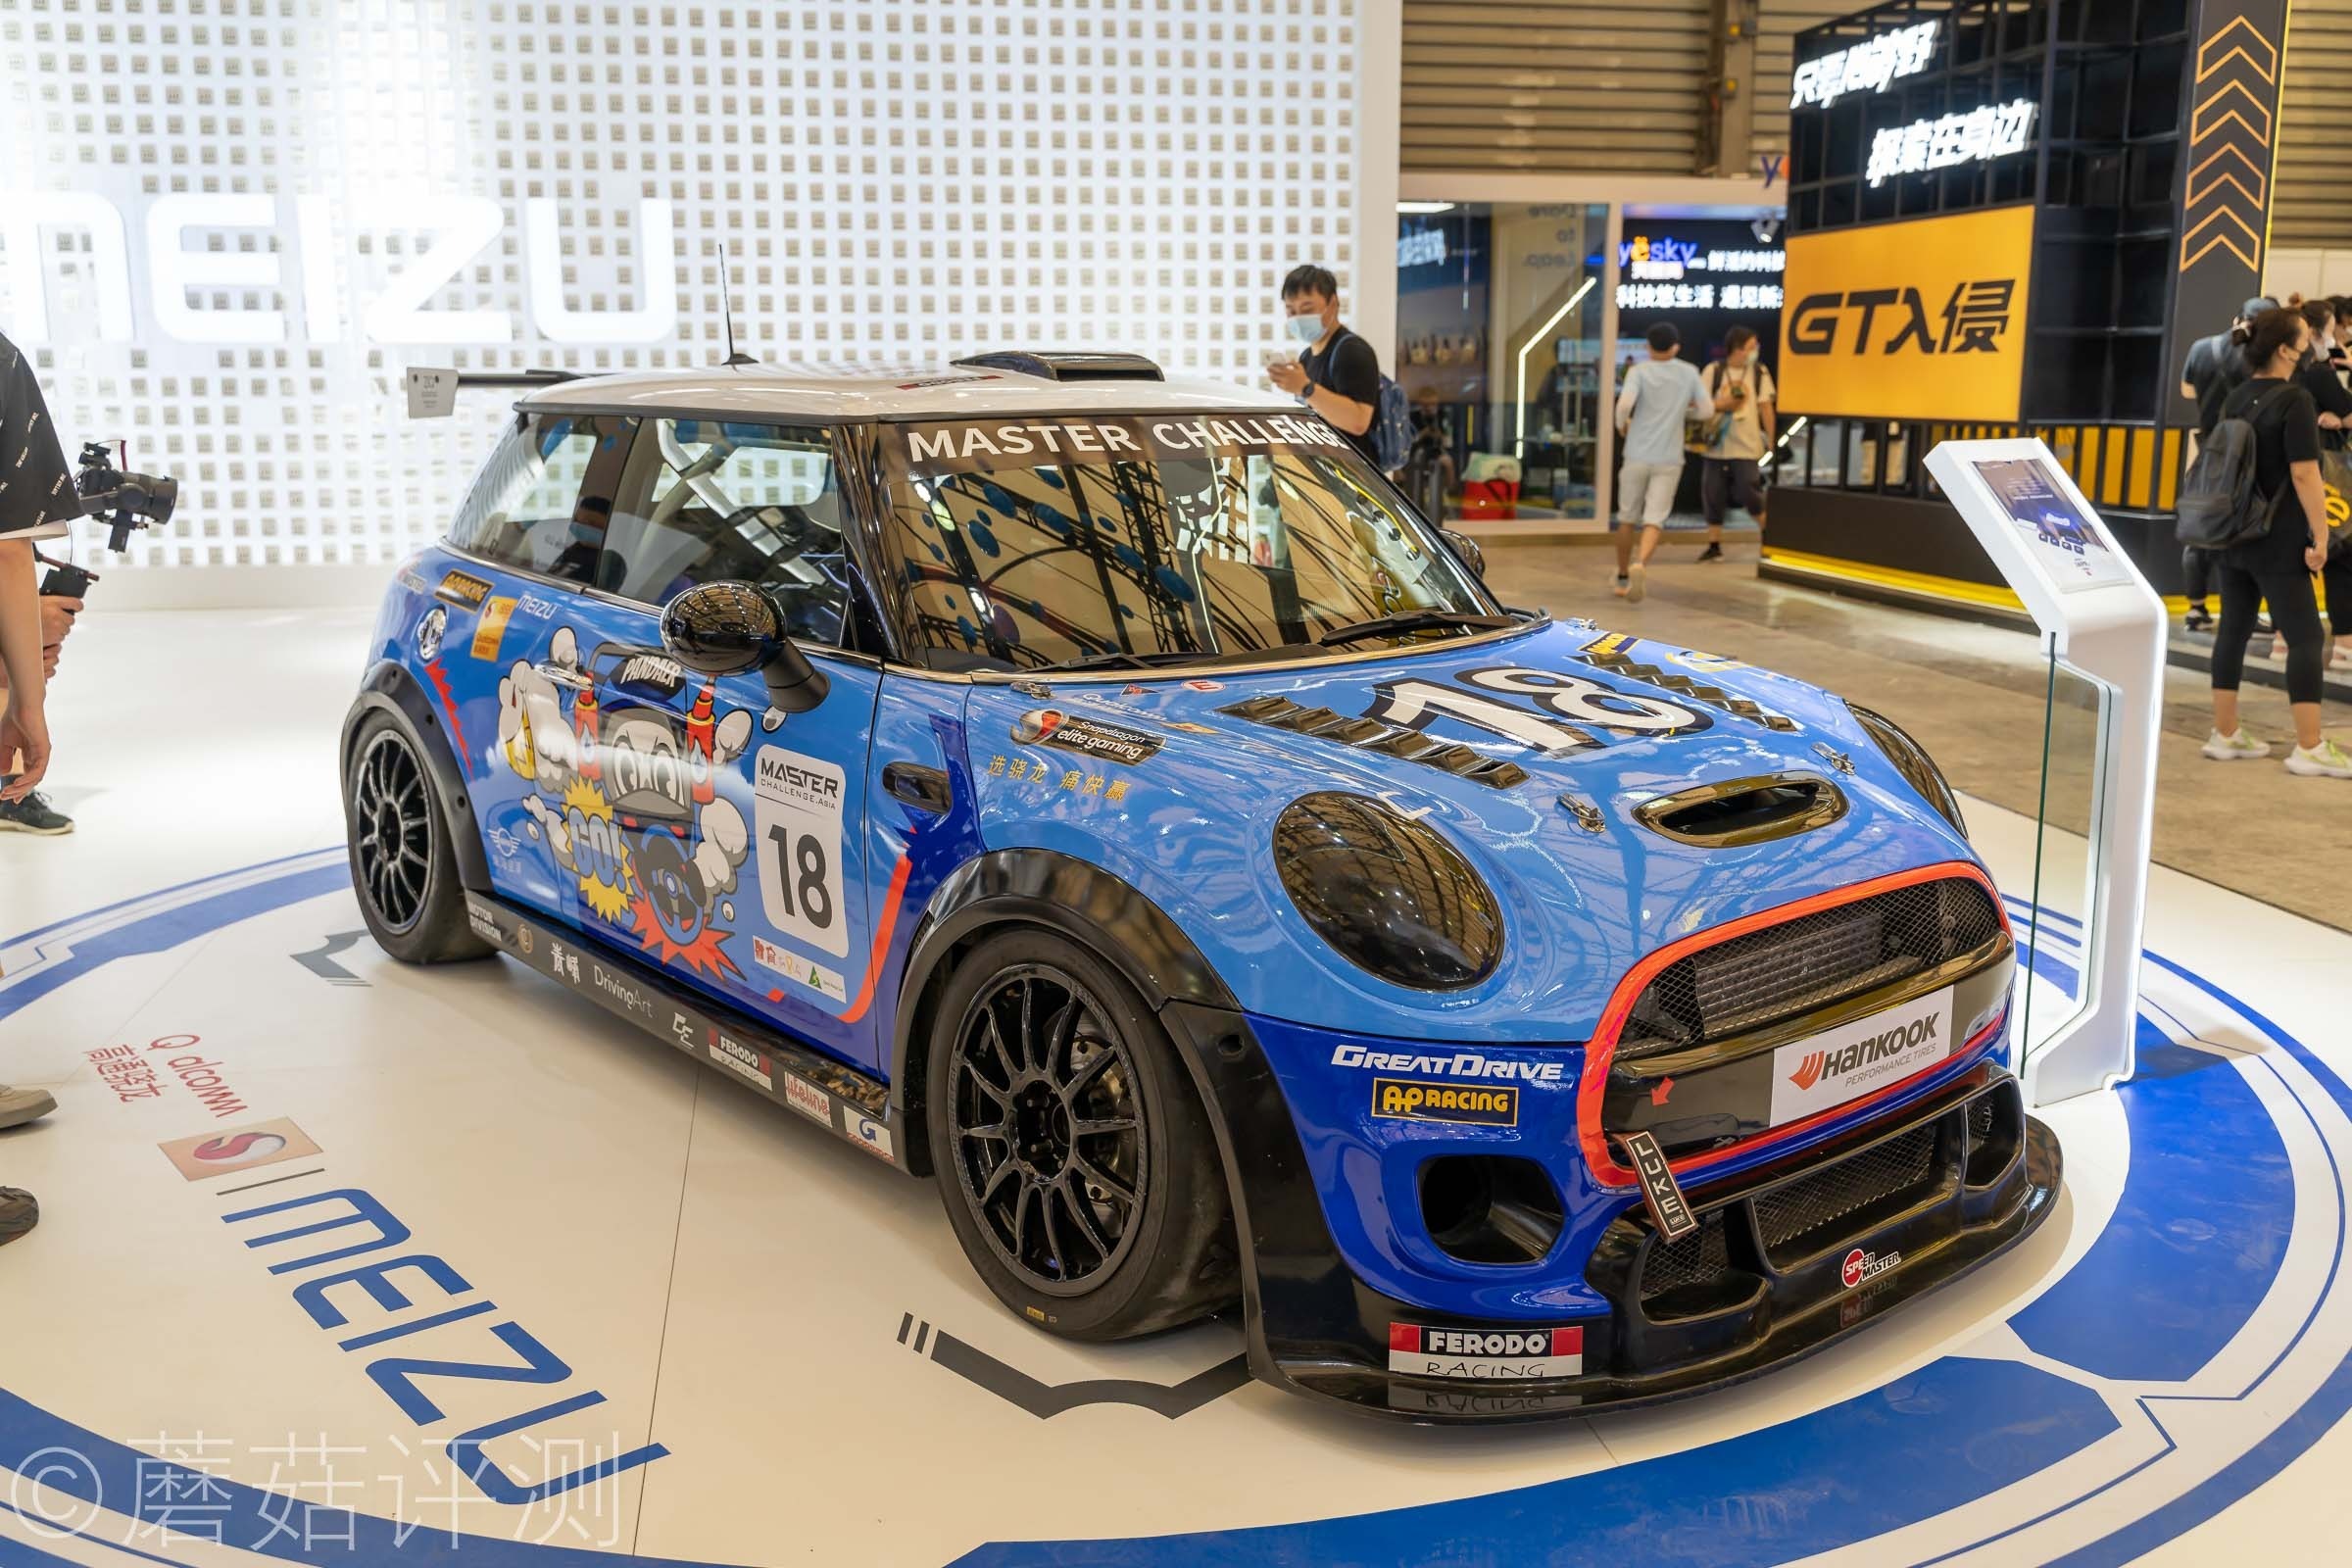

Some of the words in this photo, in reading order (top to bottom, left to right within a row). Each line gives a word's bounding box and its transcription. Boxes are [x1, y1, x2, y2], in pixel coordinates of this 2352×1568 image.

[908, 423, 1142, 463] MASTER
[1152, 415, 1350, 452] CHALLENGE
[516, 594, 559, 619] MEIZU
[620, 656, 681, 687] PANDAER
[1370, 666, 1707, 758] 18
[1057, 729, 1087, 744] elite
[1086, 737, 1143, 760] gaming
[1080, 721, 1146, 744] Snapdragon
[761, 758, 838, 799] MASTER
[988, 754, 1050, 785] 选骁龙
[1059, 769, 1130, 802] 痛快赢
[768, 823, 833, 929] 18
[720, 1035, 760, 1068] FERODO
[1845, 1053, 1912, 1087] PERFORMANCE
[1913, 1043, 1936, 1059] TIRES
[1425, 1089, 1508, 1112] RACING
[1635, 1142, 1681, 1215] LUKE
[1845, 1252, 1876, 1276] SPEED
[1862, 1251, 1901, 1281] MASTER
[220, 1188, 671, 1505] MEIZU
[1429, 1331, 1546, 1354] FERODO
[1426, 1361, 1545, 1378] RACING
